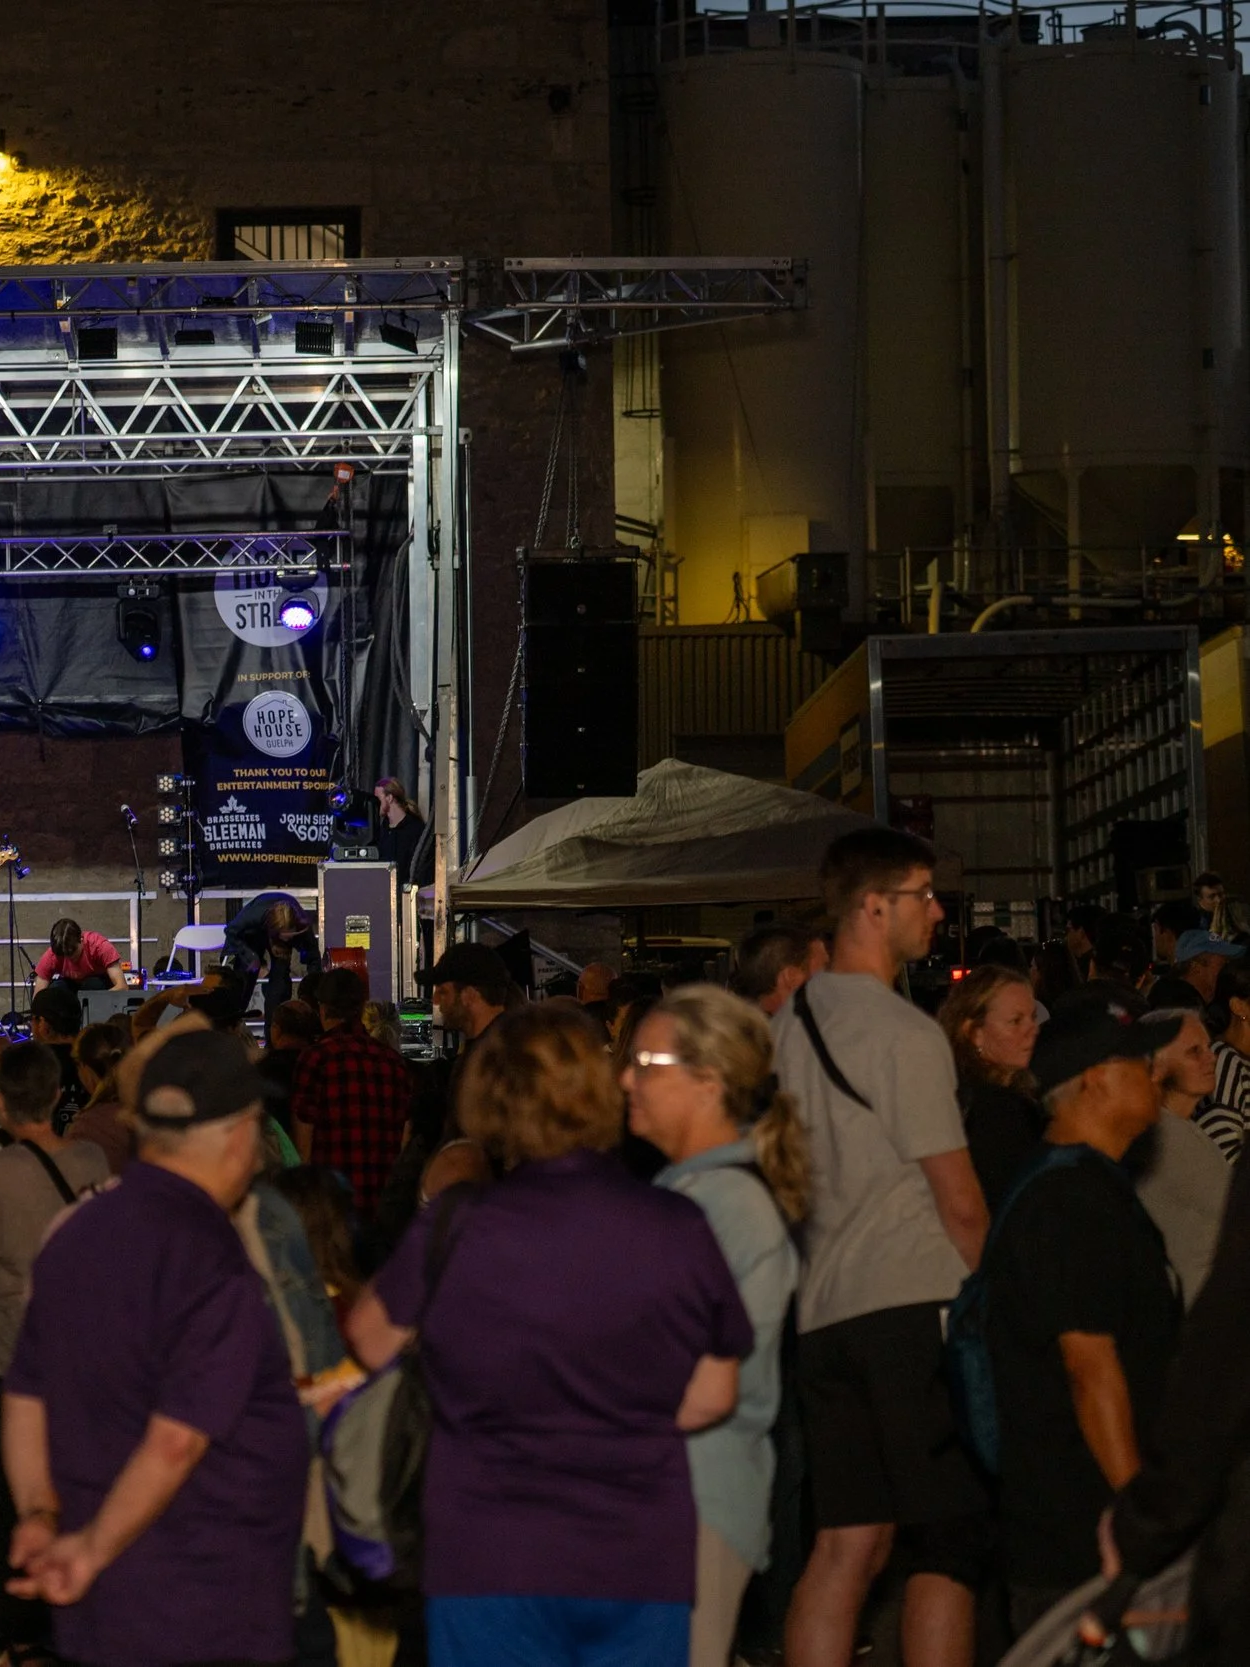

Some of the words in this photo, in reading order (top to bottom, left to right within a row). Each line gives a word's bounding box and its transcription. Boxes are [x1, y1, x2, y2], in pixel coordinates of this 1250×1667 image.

[254, 591, 265, 600] IN
[266, 590, 282, 600] TH
[237, 674, 248, 682] IN
[249, 671, 295, 682] SUPPORT
[295, 670, 311, 679] OF:
[257, 709, 295, 725] HOPE
[254, 724, 303, 738] HOUSE
[266, 738, 294, 749] GUELPH
[233, 769, 268, 777] THANK
[270, 768, 292, 777] YOU
[294, 768, 308, 777] TO
[217, 781, 301, 791] ENTERTAINMENT
[207, 814, 260, 824] BRASSERIES
[279, 813, 312, 825] JOHN
[312, 814, 334, 825] SIEM
[203, 823, 266, 843] SLEEMAN
[210, 841, 262, 851] BREWERIES
